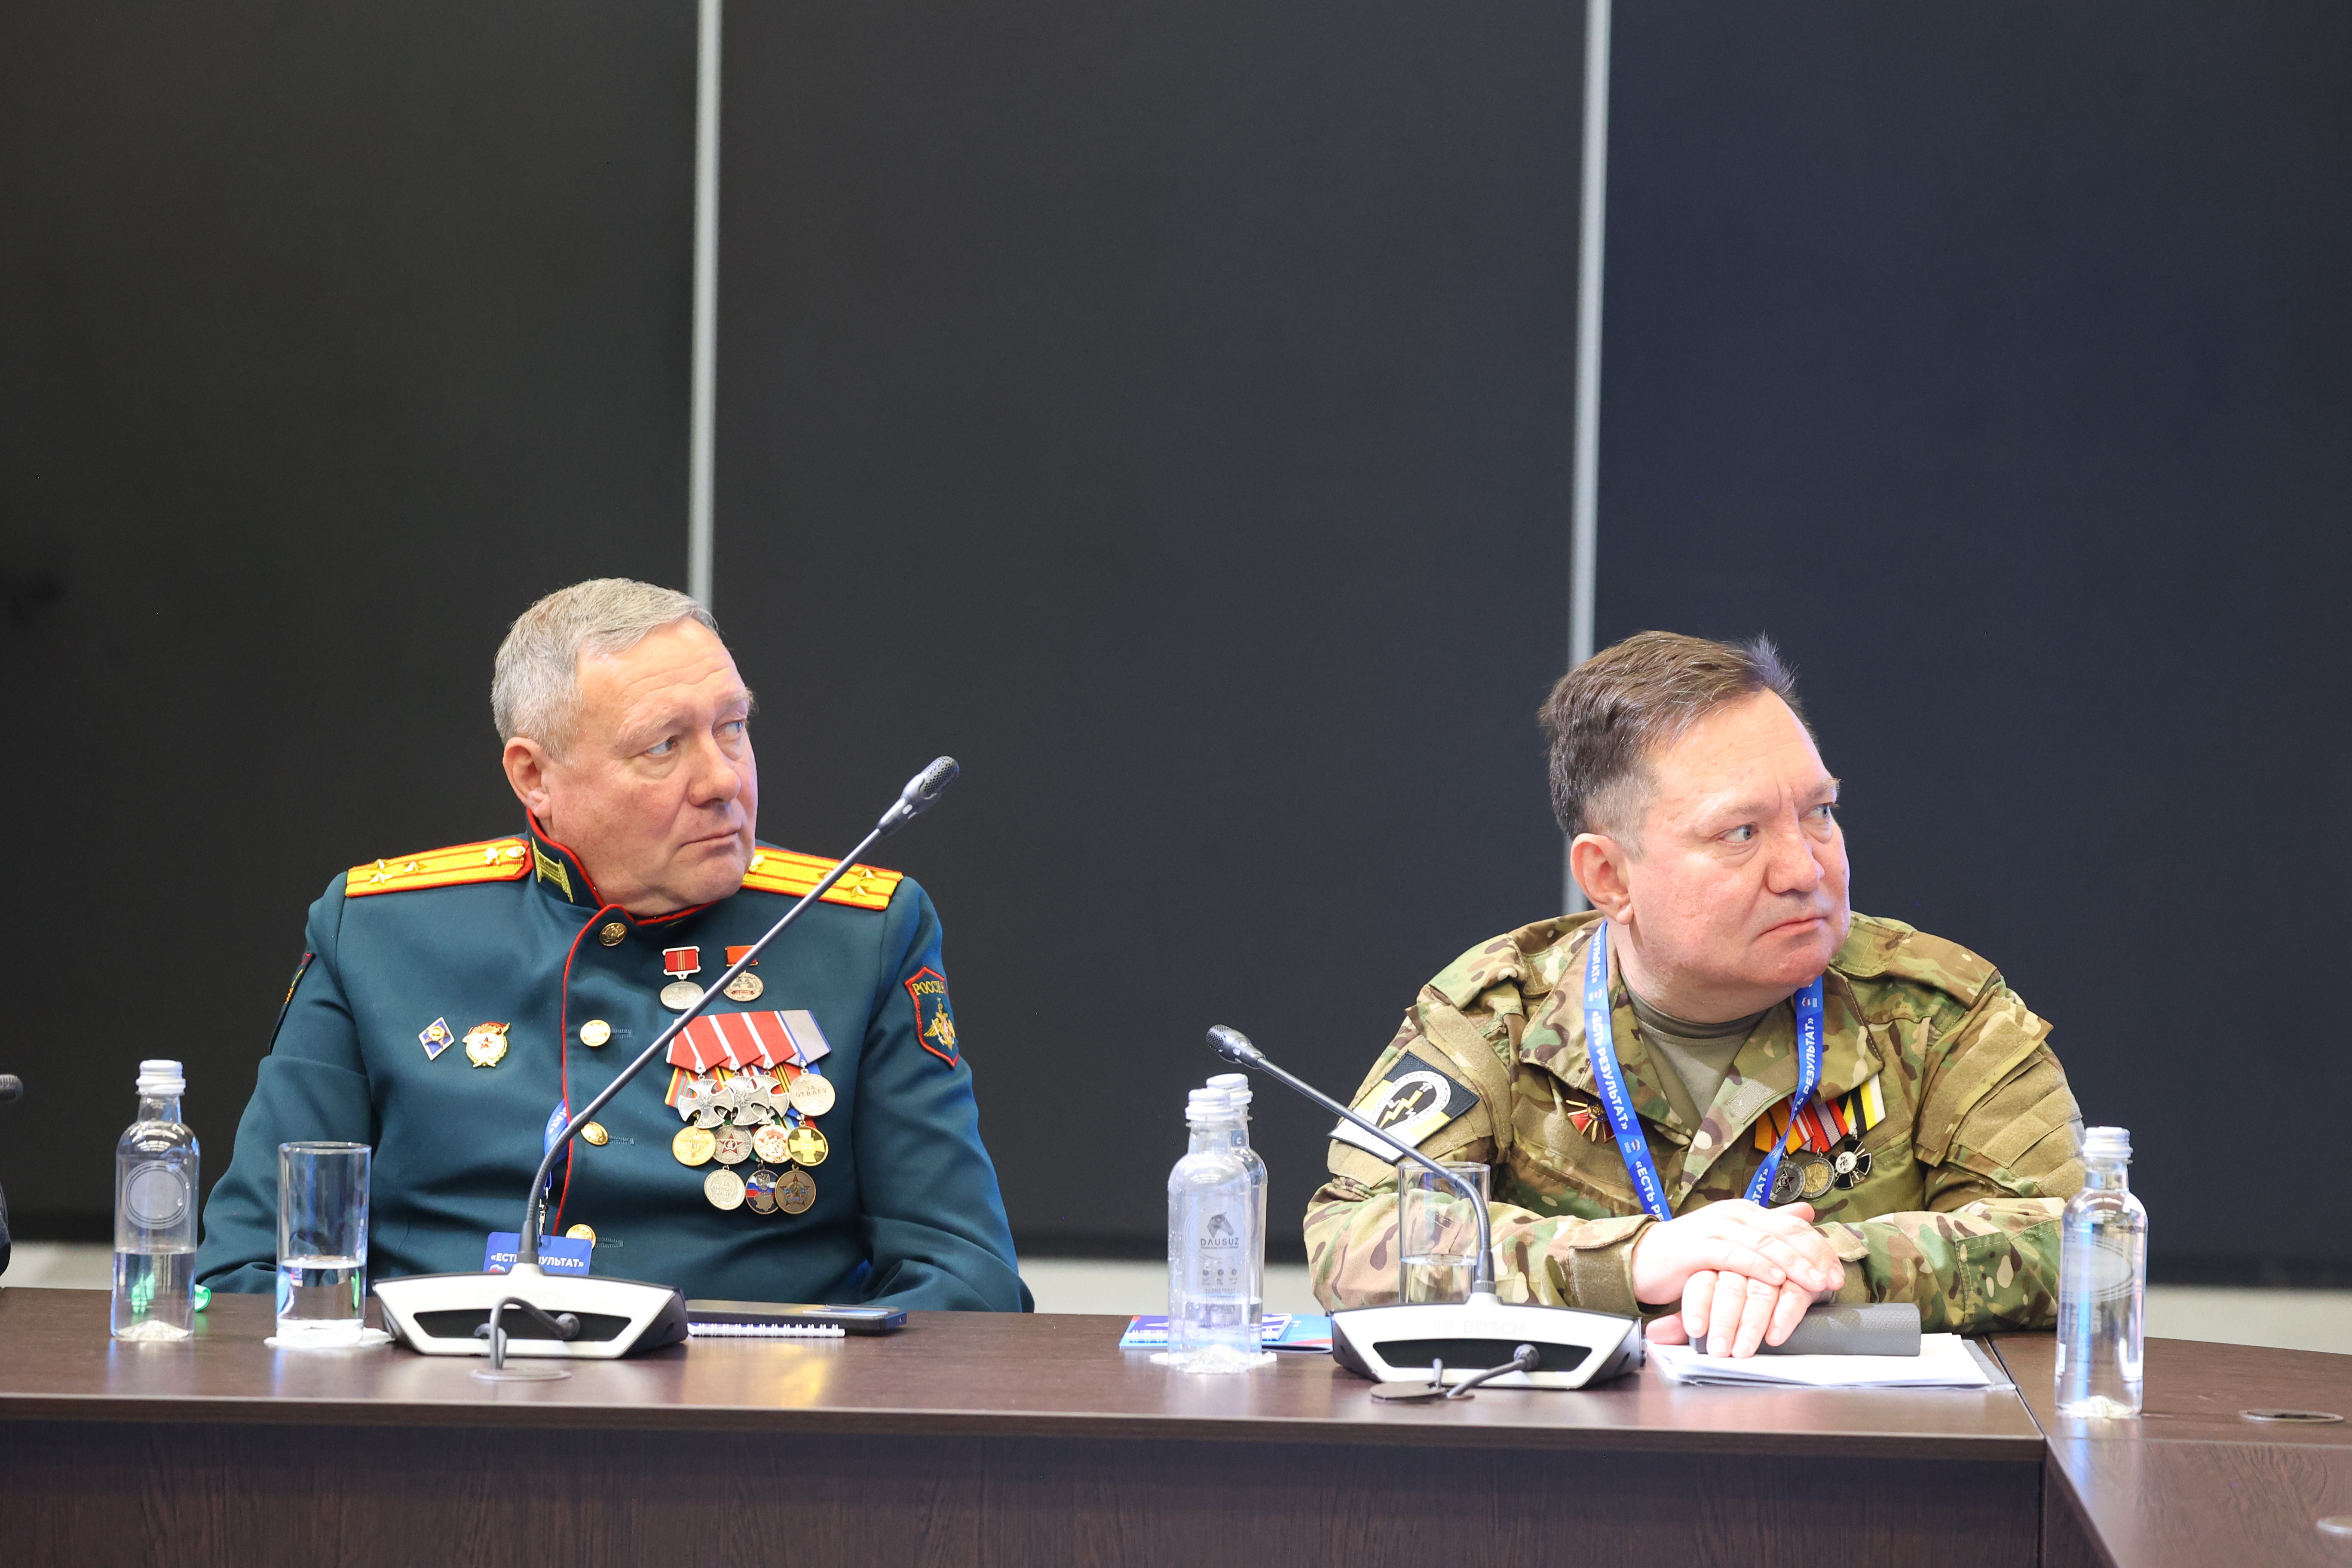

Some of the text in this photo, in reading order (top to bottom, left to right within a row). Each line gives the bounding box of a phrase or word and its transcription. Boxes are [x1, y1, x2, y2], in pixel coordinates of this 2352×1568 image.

[1592, 1011, 1629, 1130] «ЕСТЬ РЕЗУЛЬТАТ»
[1803, 1017, 1816, 1095] РЕЗУЛЬТАТ»
[795, 1087, 827, 1098] ОТВАГУ
[1635, 1161, 1655, 1203] «ЕСТЬ
[1200, 1237, 1239, 1246] DAUSUZ
